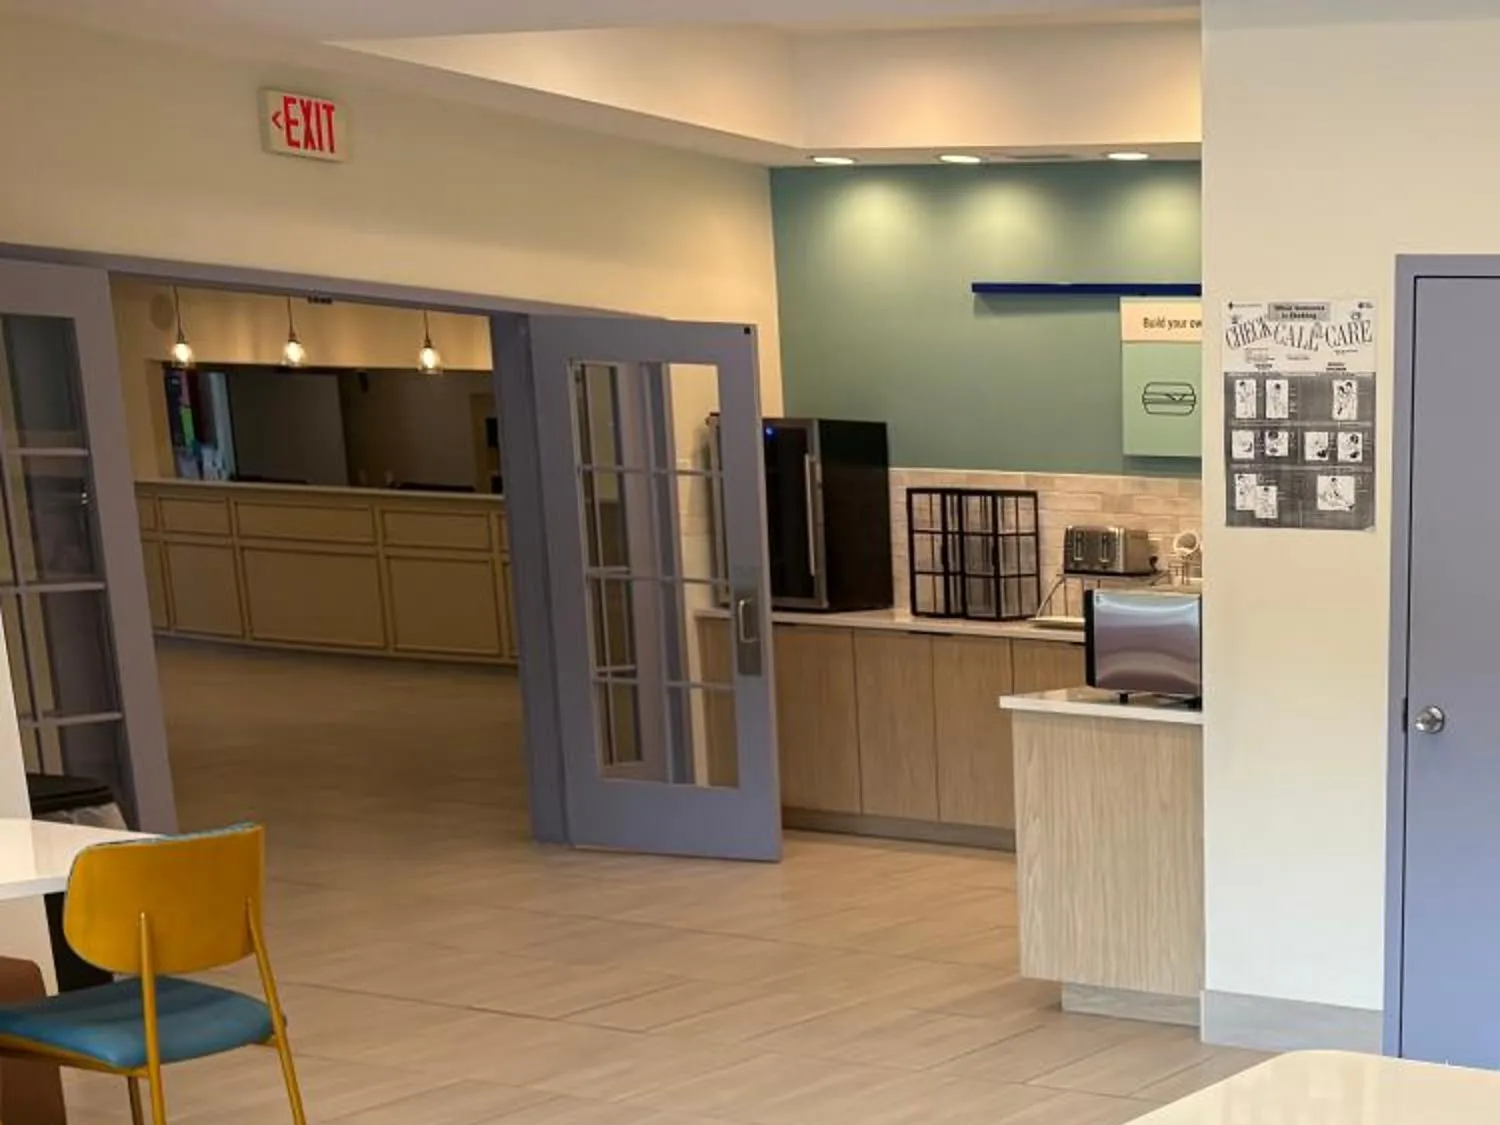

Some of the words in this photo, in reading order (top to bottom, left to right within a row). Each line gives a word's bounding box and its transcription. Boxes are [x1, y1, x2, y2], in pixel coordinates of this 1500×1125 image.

[283, 96, 335, 153] EXIT
[1225, 315, 1272, 350] CHECK
[1325, 319, 1373, 349] CARE
